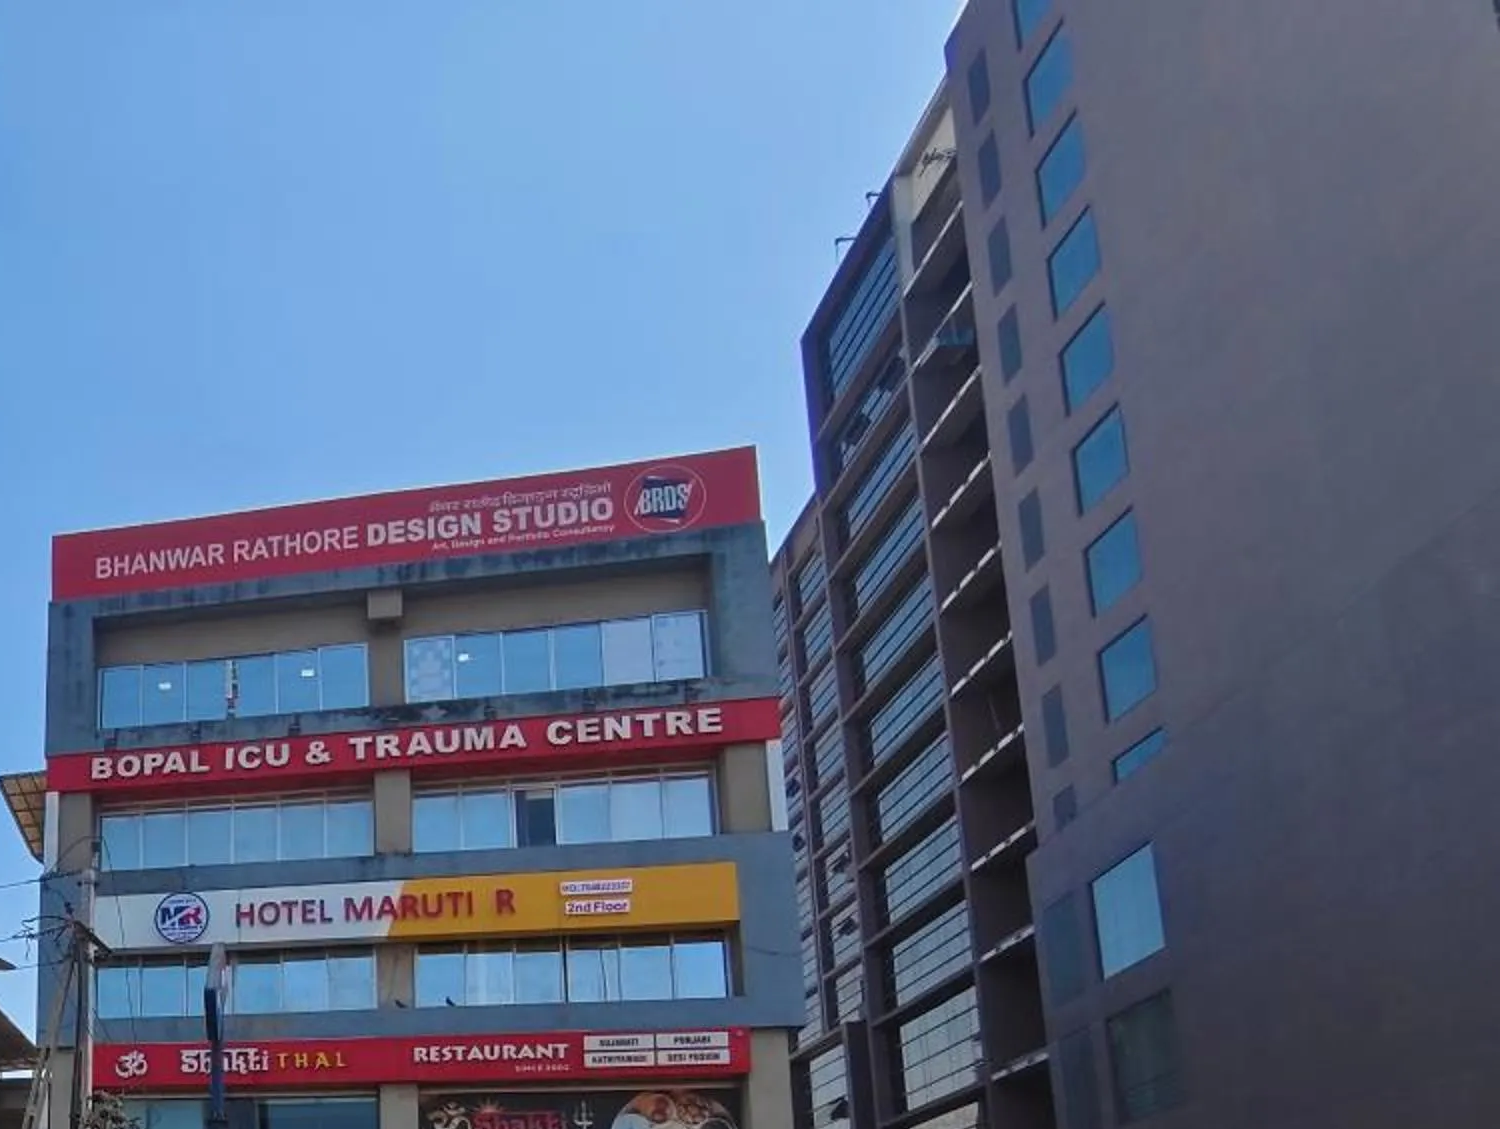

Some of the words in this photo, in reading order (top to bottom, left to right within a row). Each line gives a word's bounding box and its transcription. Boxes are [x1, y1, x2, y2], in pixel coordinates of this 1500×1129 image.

[636, 481, 694, 516] BRDS
[95, 543, 225, 579] BHANWAR
[233, 525, 360, 563] RATHORE
[367, 512, 483, 547] DESIGN
[492, 497, 614, 534] STUDIO
[91, 750, 209, 781] BOPAL
[224, 742, 291, 770] ICU
[305, 739, 332, 765] &
[349, 722, 528, 761] TRAUMA
[547, 707, 724, 746] CENTRE
[235, 899, 334, 928] HOTEL
[344, 885, 475, 922] MARUTI
[494, 888, 516, 917] R
[566, 902, 592, 913] 2nd
[594, 900, 628, 912] Floor
[180, 1047, 270, 1074] Shkti
[277, 1052, 348, 1071] THAL
[413, 1043, 569, 1063] RESTAURANT
